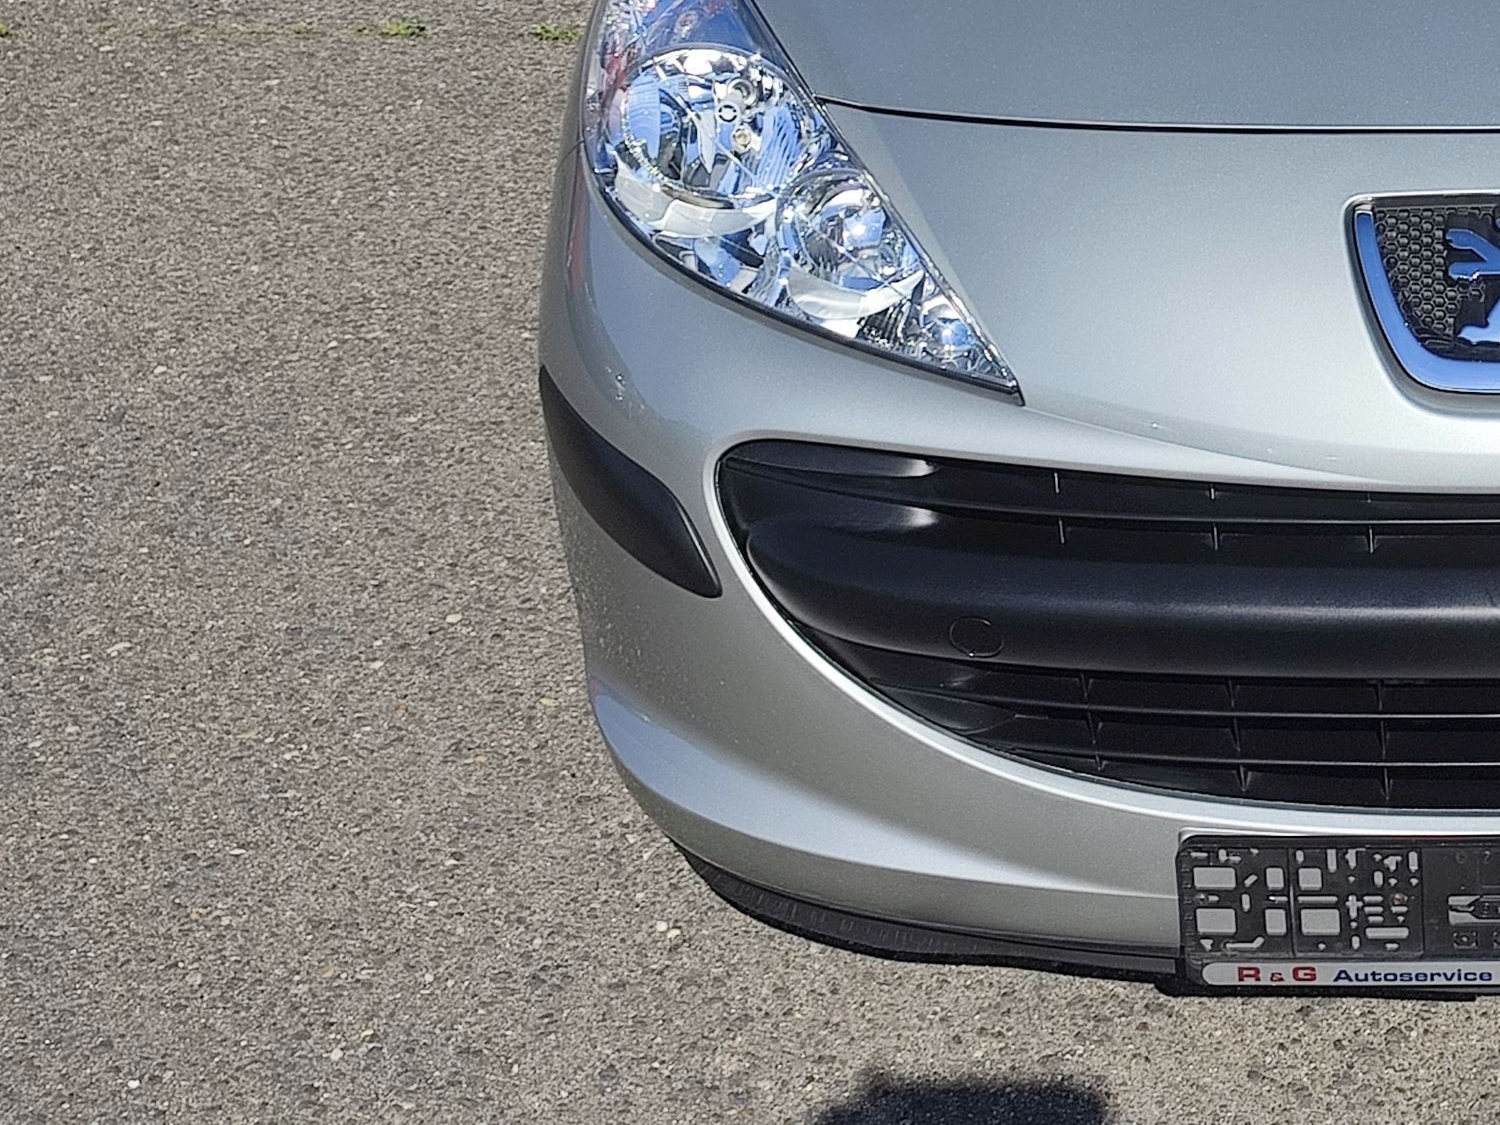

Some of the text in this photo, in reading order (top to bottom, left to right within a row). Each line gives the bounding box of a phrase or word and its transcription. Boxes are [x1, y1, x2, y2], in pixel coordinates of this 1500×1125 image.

[1237, 966, 1261, 982] R
[1270, 972, 1285, 982] &
[1292, 966, 1317, 982] G
[1333, 969, 1493, 982] Autoservice
